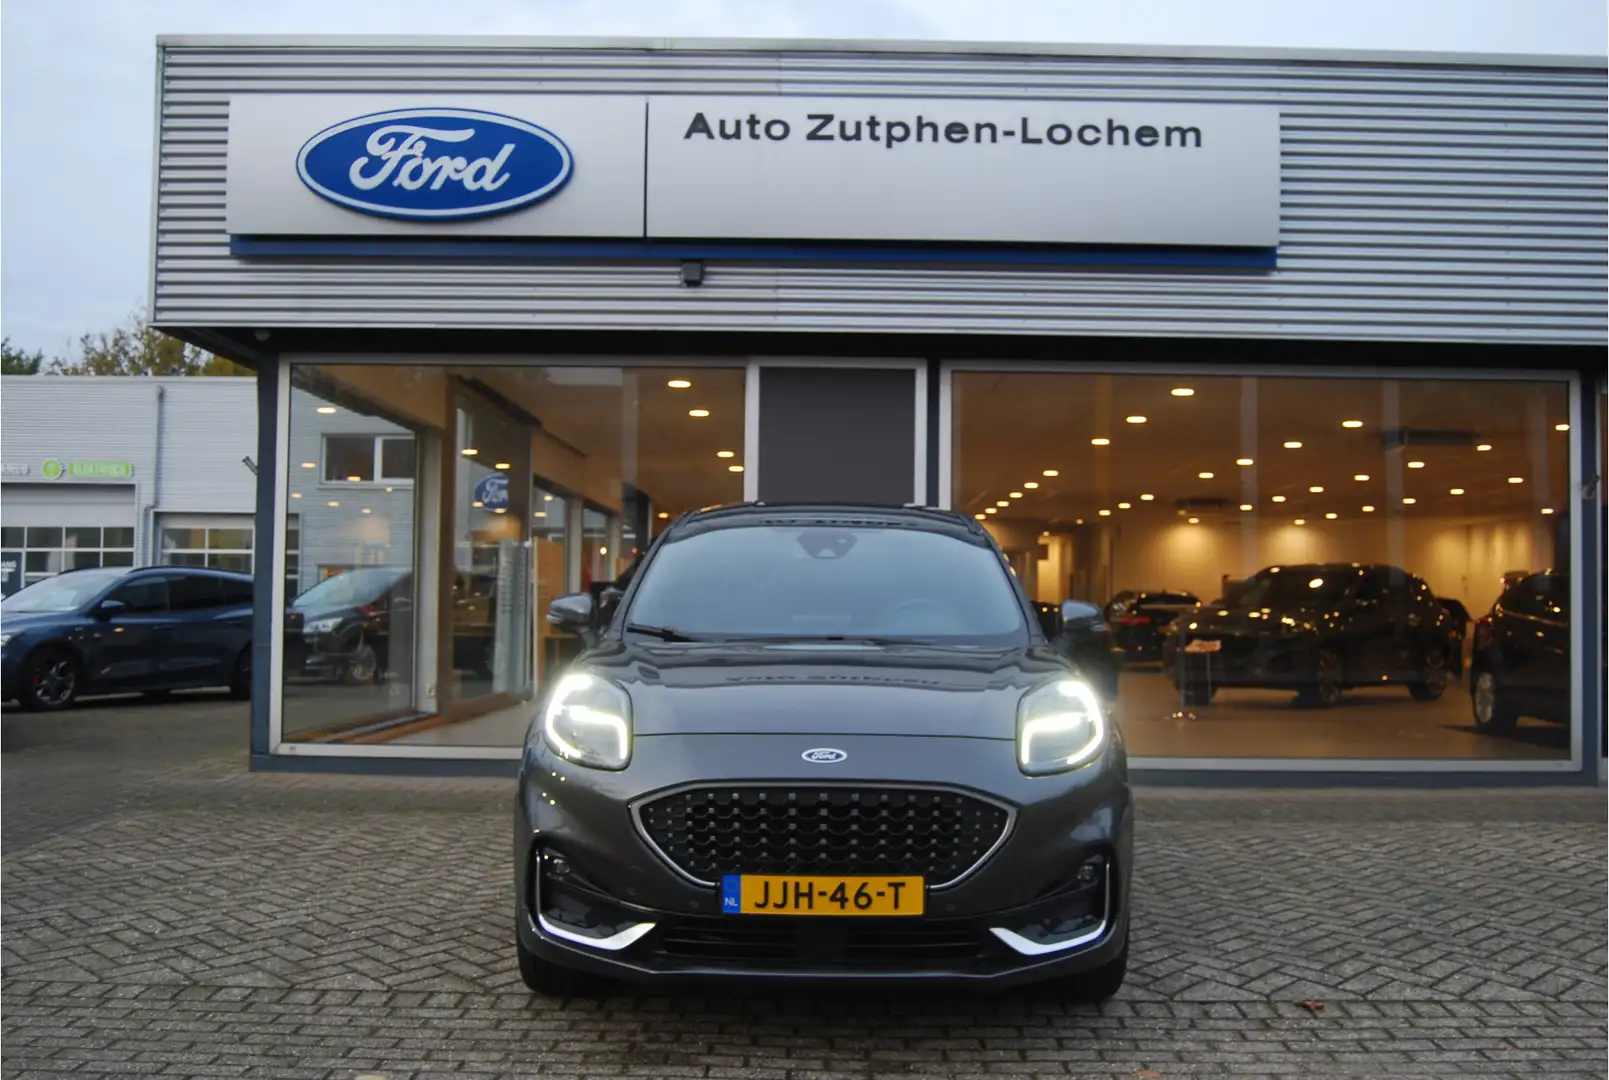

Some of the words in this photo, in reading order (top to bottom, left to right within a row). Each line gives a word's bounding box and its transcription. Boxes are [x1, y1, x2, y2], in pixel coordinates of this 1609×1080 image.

[684, 112, 790, 140] Auto
[806, 114, 1202, 148] Zutphen-Lochem
[349, 125, 516, 191] Ford
[724, 897, 738, 906] NL
[754, 881, 906, 909] JJH-46-T
